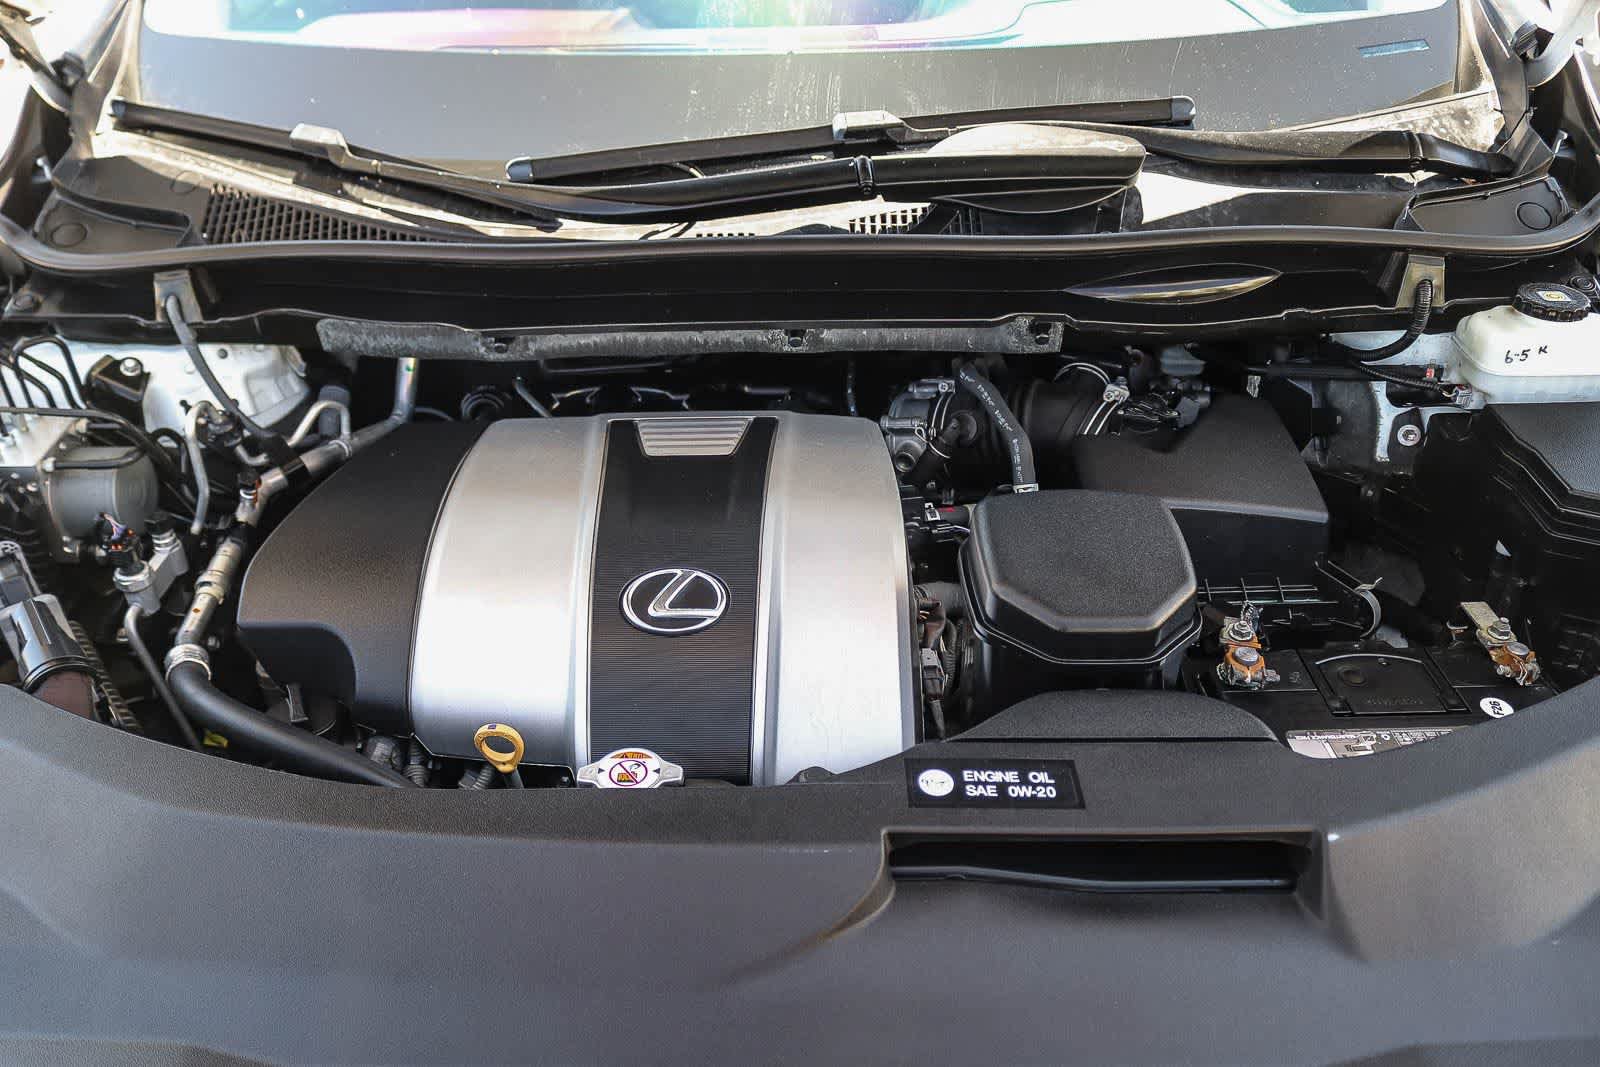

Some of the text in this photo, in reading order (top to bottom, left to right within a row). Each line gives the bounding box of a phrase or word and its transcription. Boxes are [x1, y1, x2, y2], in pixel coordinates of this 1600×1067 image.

[962, 770, 1056, 784] ENGINE OIL
[965, 784, 1057, 798] SAE 0W-20
